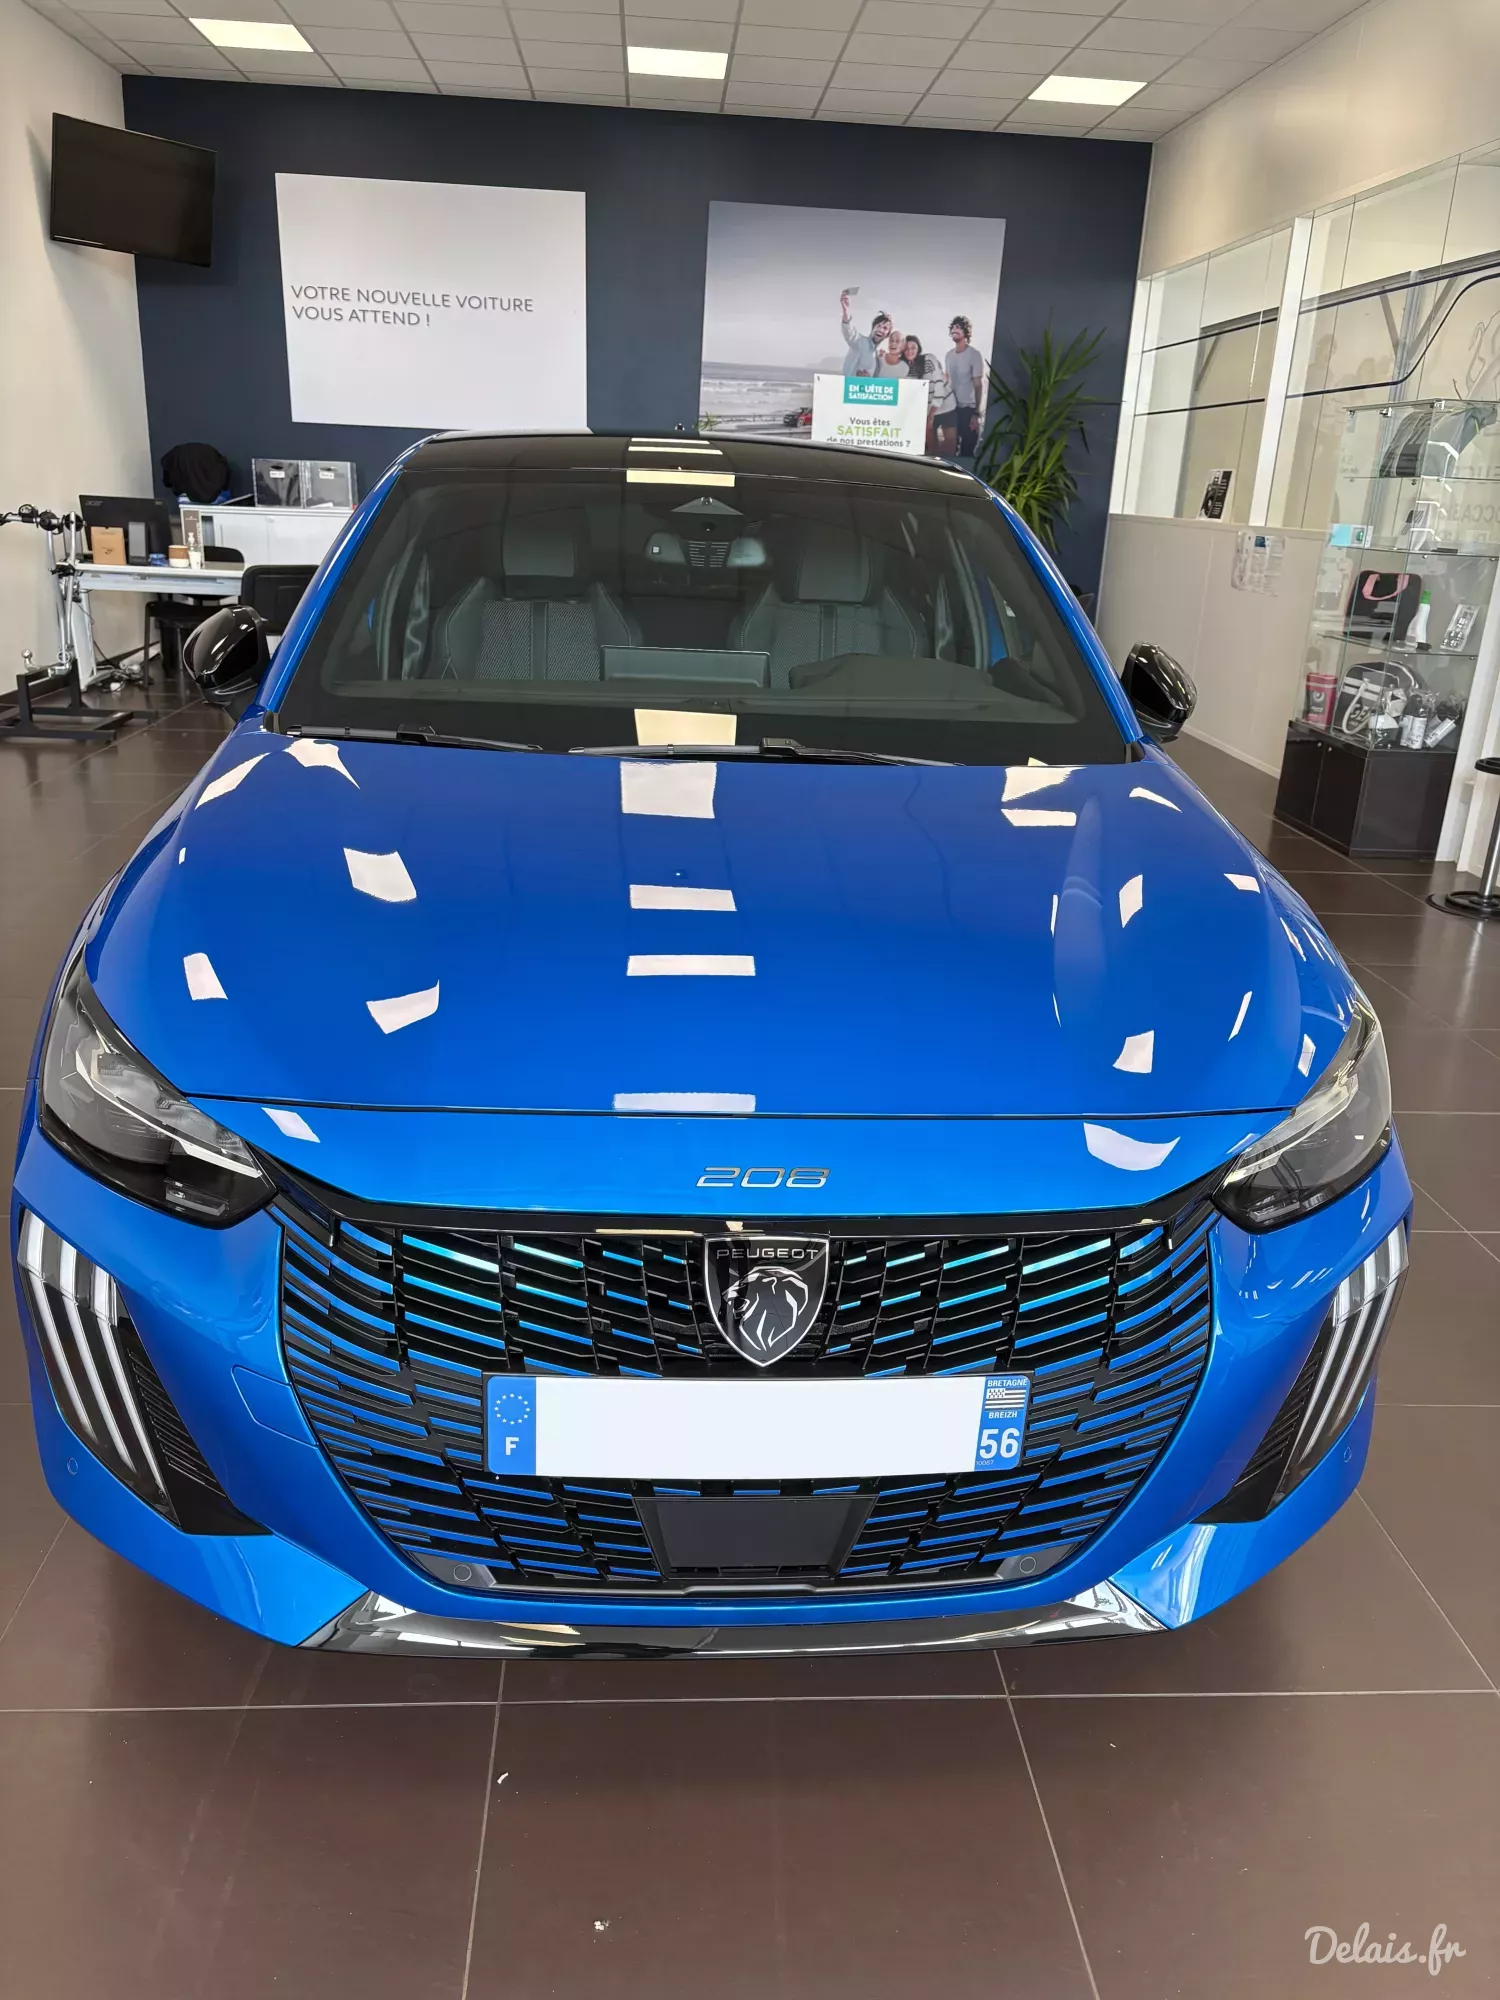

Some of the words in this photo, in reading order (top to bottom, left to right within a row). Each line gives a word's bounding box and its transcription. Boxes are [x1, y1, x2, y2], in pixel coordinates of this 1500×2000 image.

[291, 285, 351, 301] VOTRE
[356, 288, 451, 307] NOUVELLE
[456, 295, 534, 312] VOITURE
[292, 306, 344, 321] VOUS
[348, 309, 421, 326] ATTEND
[883, 386, 894, 394] DE
[848, 393, 894, 401] SATISFACTION
[849, 417, 871, 425] Vous
[872, 418, 890, 426] êtes
[836, 426, 902, 437] SATISFAIT
[856, 439, 904, 447] prestations
[696, 1167, 831, 1188] 208
[716, 1248, 819, 1259] PEUGEOT
[988, 1379, 1028, 1387] BRETAGNE
[505, 1436, 520, 1456] F
[979, 1427, 1020, 1459] 56
